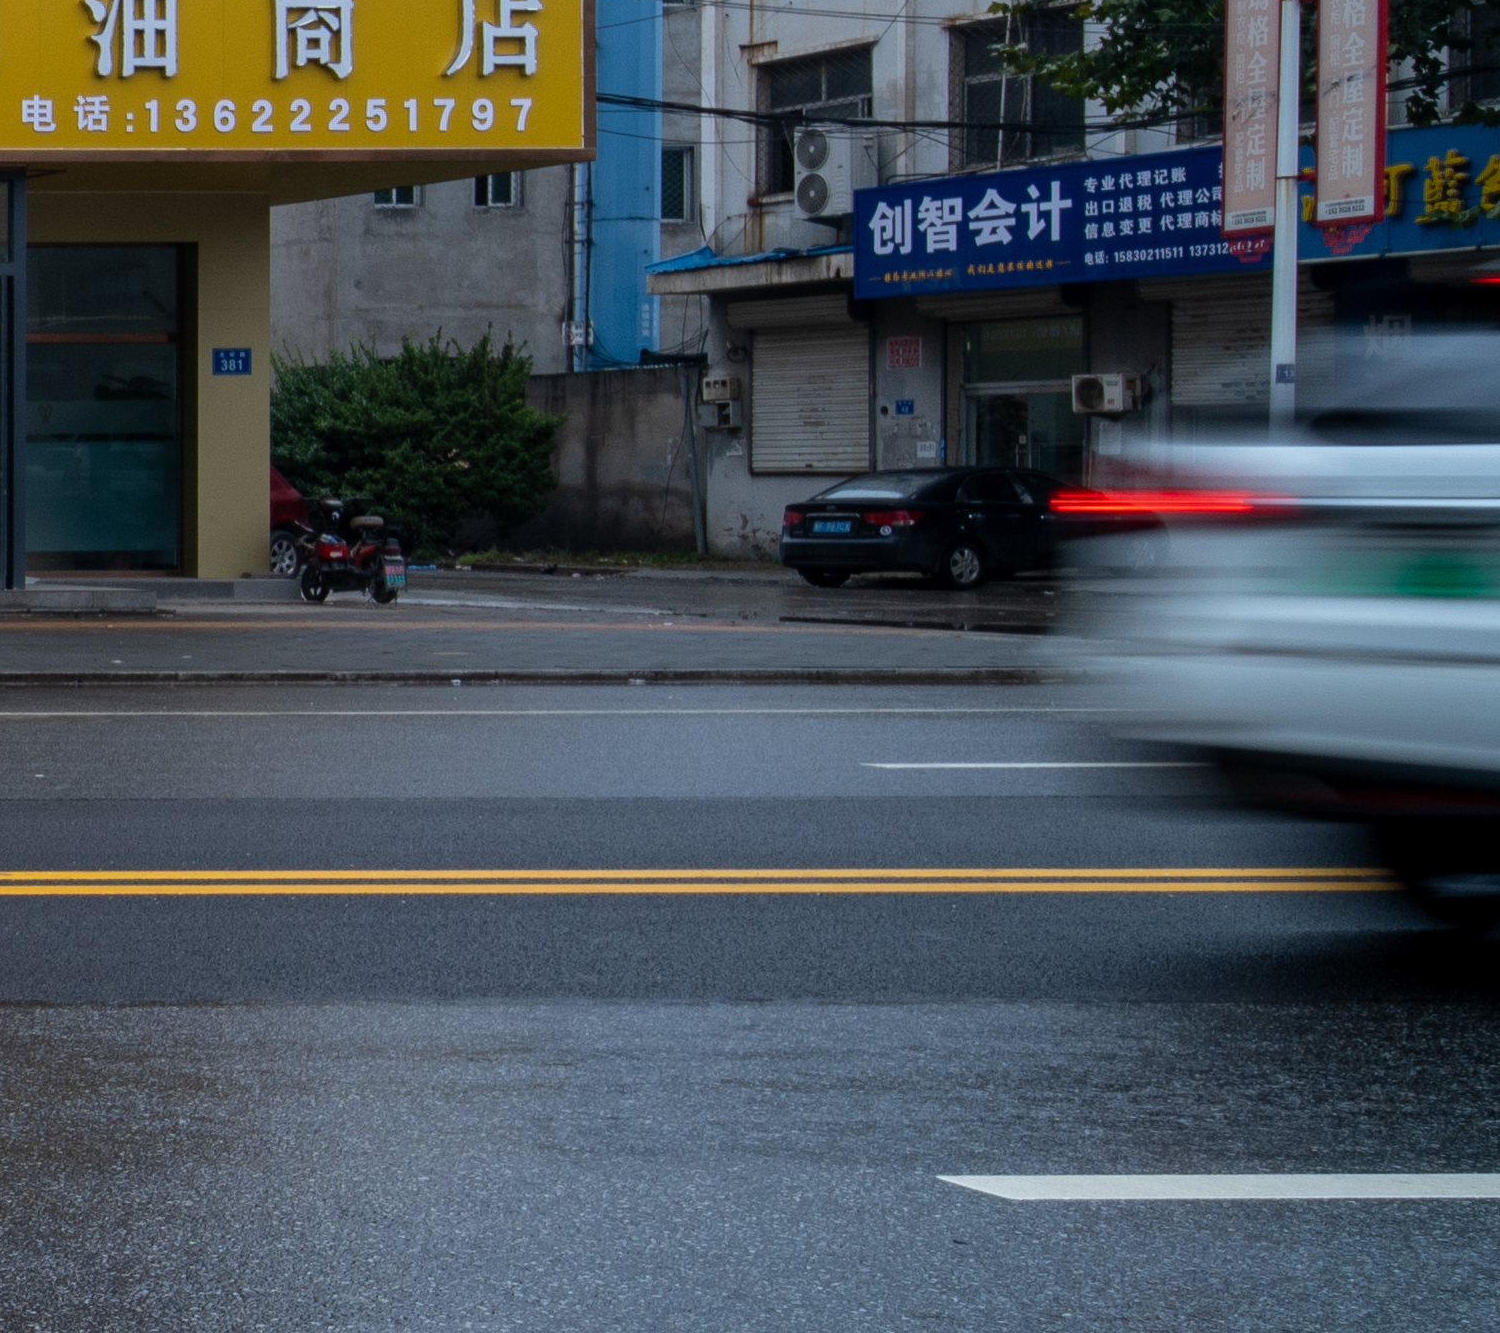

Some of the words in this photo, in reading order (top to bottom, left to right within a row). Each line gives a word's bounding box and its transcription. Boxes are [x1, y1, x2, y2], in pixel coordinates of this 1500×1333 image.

[1083, 166, 1187, 194] 专业代理记账
[1084, 194, 1153, 217] 出口退税
[869, 180, 1074, 256] 创智会计
[1084, 217, 1153, 240] 信息变更
[1114, 247, 1184, 263] 15830211511
[220, 359, 243, 371] 381
